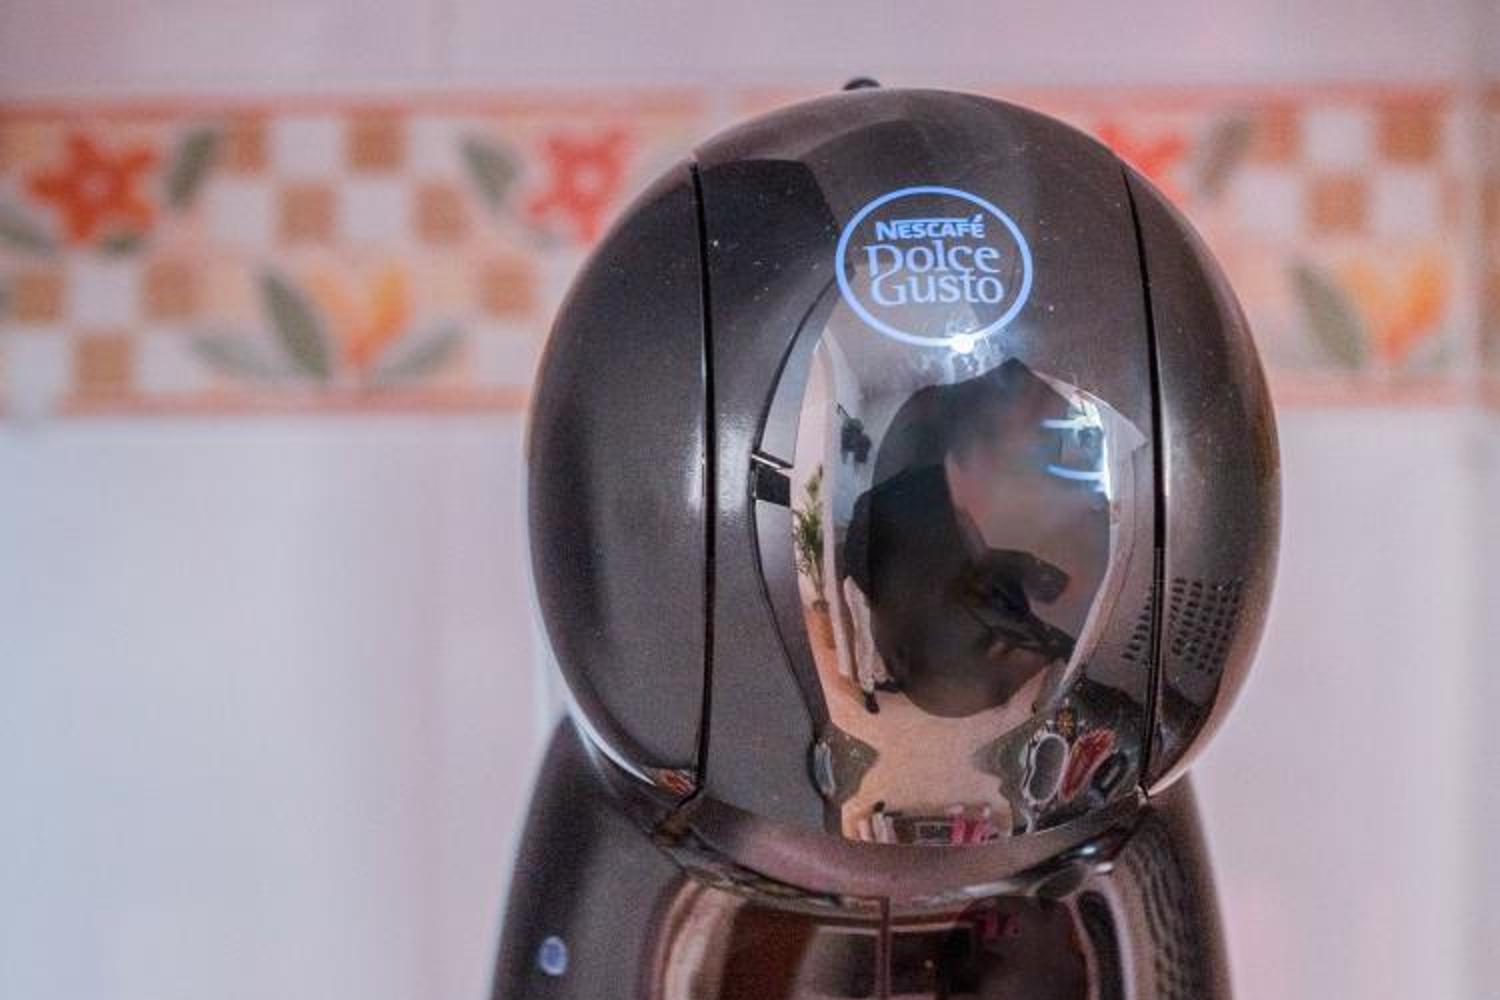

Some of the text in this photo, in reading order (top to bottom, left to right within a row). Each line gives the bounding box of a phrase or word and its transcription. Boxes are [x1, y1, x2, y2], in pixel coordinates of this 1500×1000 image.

[875, 214, 985, 240] NESCAFÉ
[864, 240, 1001, 277] Dolce
[870, 273, 1004, 306] Gusto
